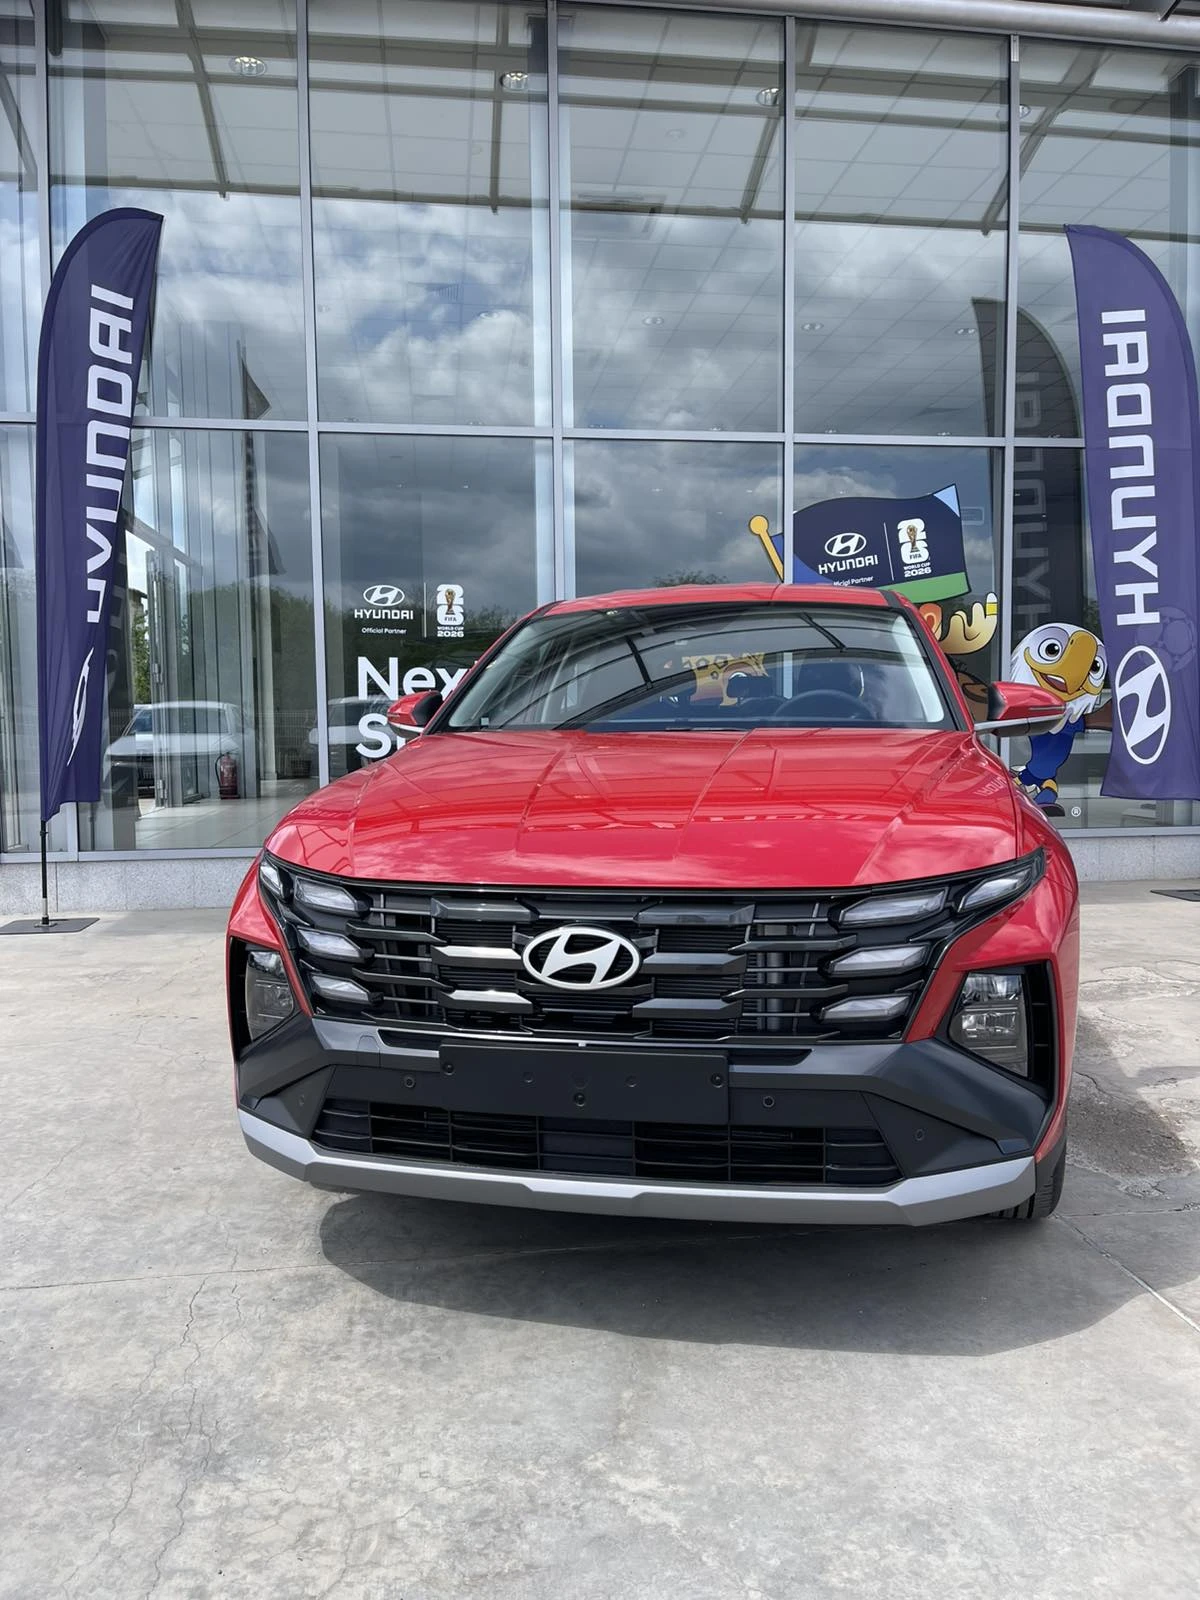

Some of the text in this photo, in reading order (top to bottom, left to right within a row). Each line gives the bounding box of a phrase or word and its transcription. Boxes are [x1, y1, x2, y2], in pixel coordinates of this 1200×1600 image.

[818, 554, 879, 575] HYUNDAI
[903, 566, 932, 577] 2026
[850, 575, 874, 584] Partner
[354, 608, 414, 620] HYUNDAI
[436, 630, 465, 638] 2026
[357, 656, 478, 701] Nex
[355, 713, 406, 759] S
